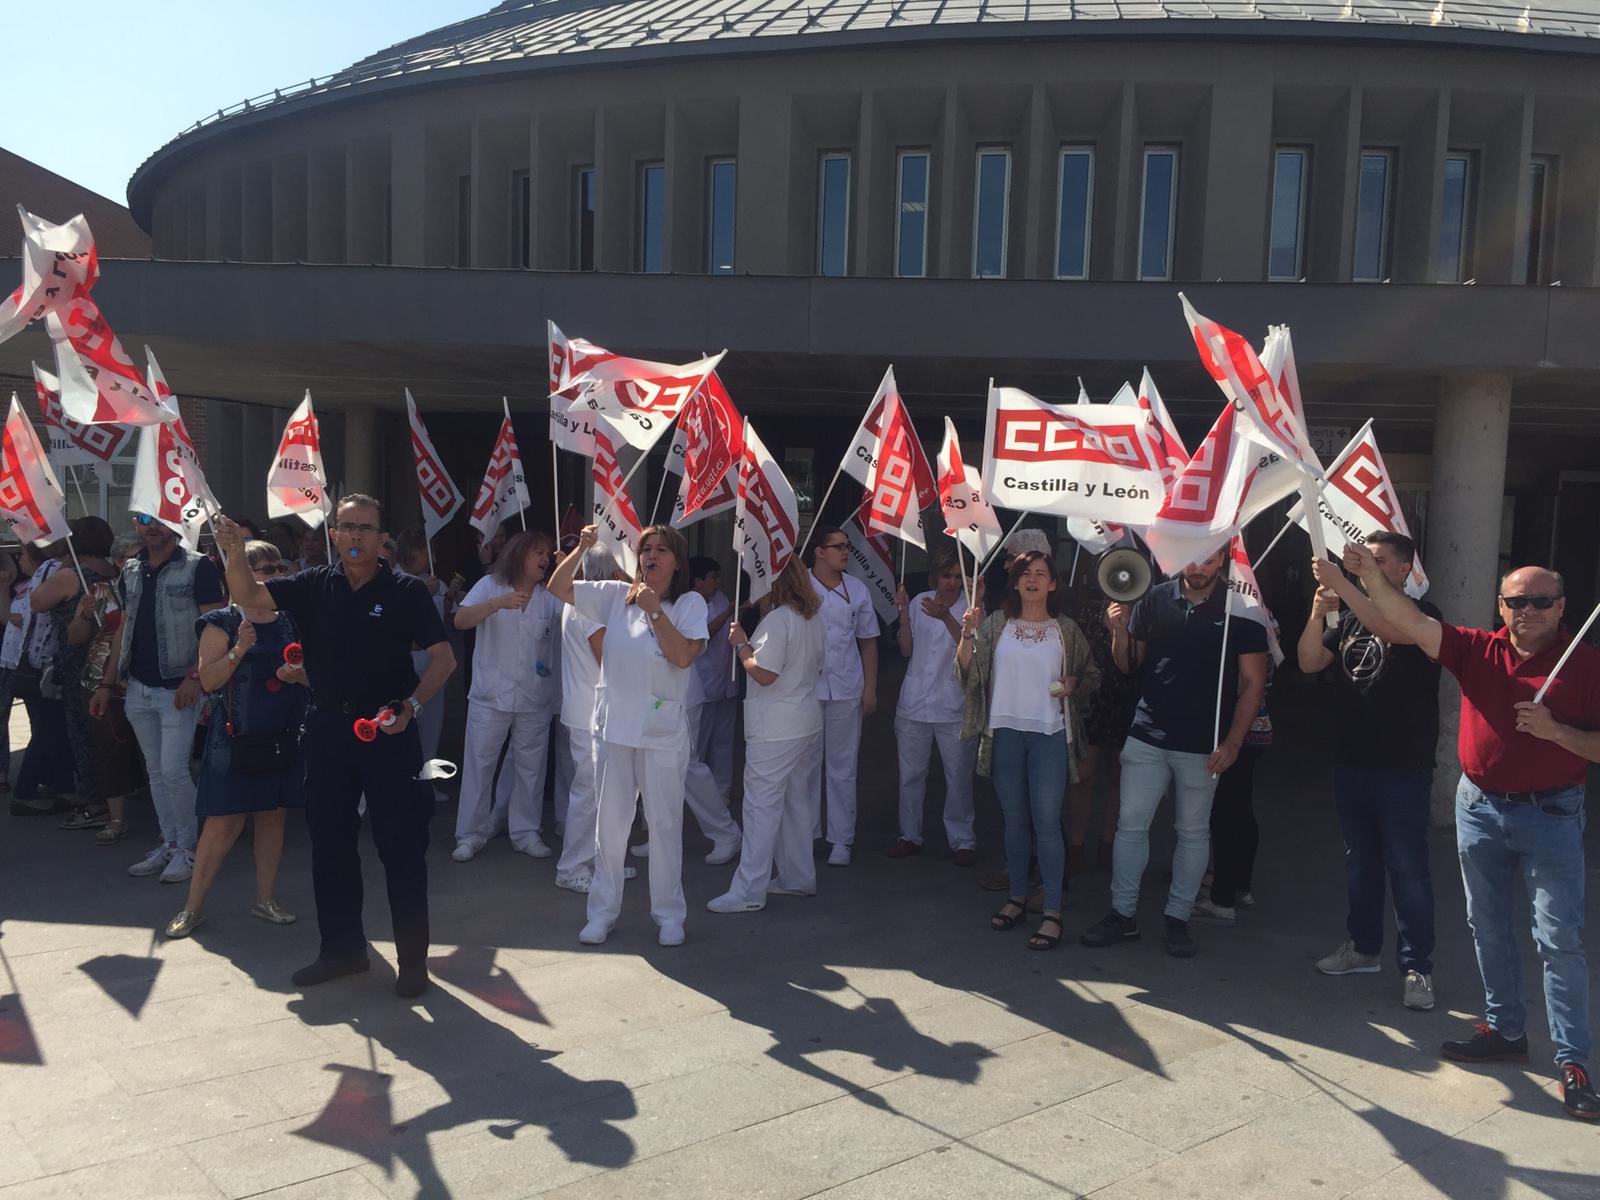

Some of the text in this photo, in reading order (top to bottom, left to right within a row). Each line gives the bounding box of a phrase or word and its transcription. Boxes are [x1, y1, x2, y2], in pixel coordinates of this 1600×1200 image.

[1004, 420, 1140, 463] CCOO
[1315, 439, 1333, 455] 21
[1003, 476, 1150, 500] Castilla y León
